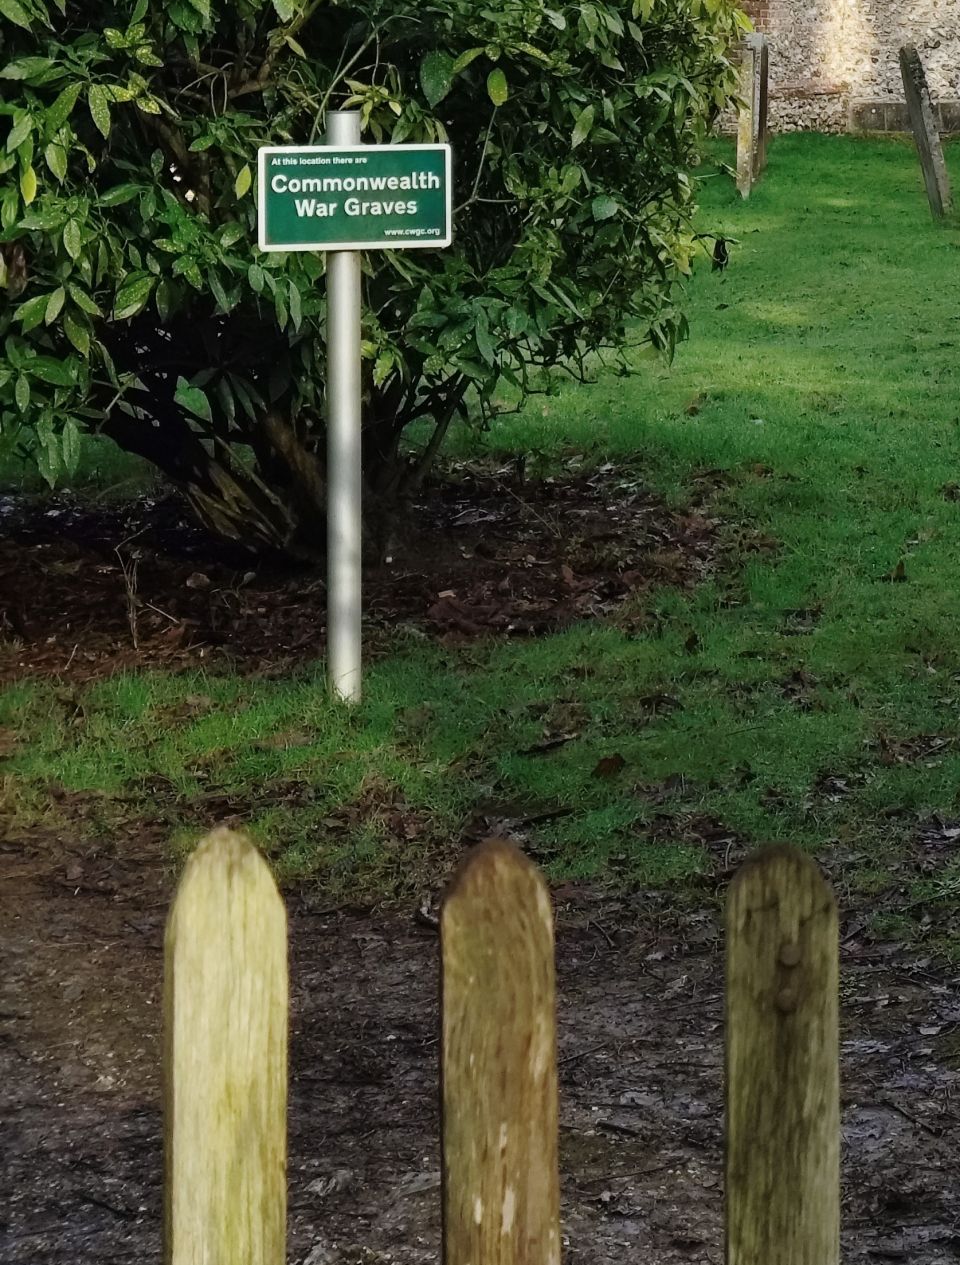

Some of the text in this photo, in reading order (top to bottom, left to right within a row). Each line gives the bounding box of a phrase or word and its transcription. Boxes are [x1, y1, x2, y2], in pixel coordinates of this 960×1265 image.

[271, 157, 281, 166] At
[282, 157, 298, 165] this
[299, 156, 331, 165] location
[332, 156, 353, 164] there
[271, 171, 440, 193] Commonwealth
[294, 197, 418, 217] War Graves
[384, 228, 441, 237] www.cwgc.org
